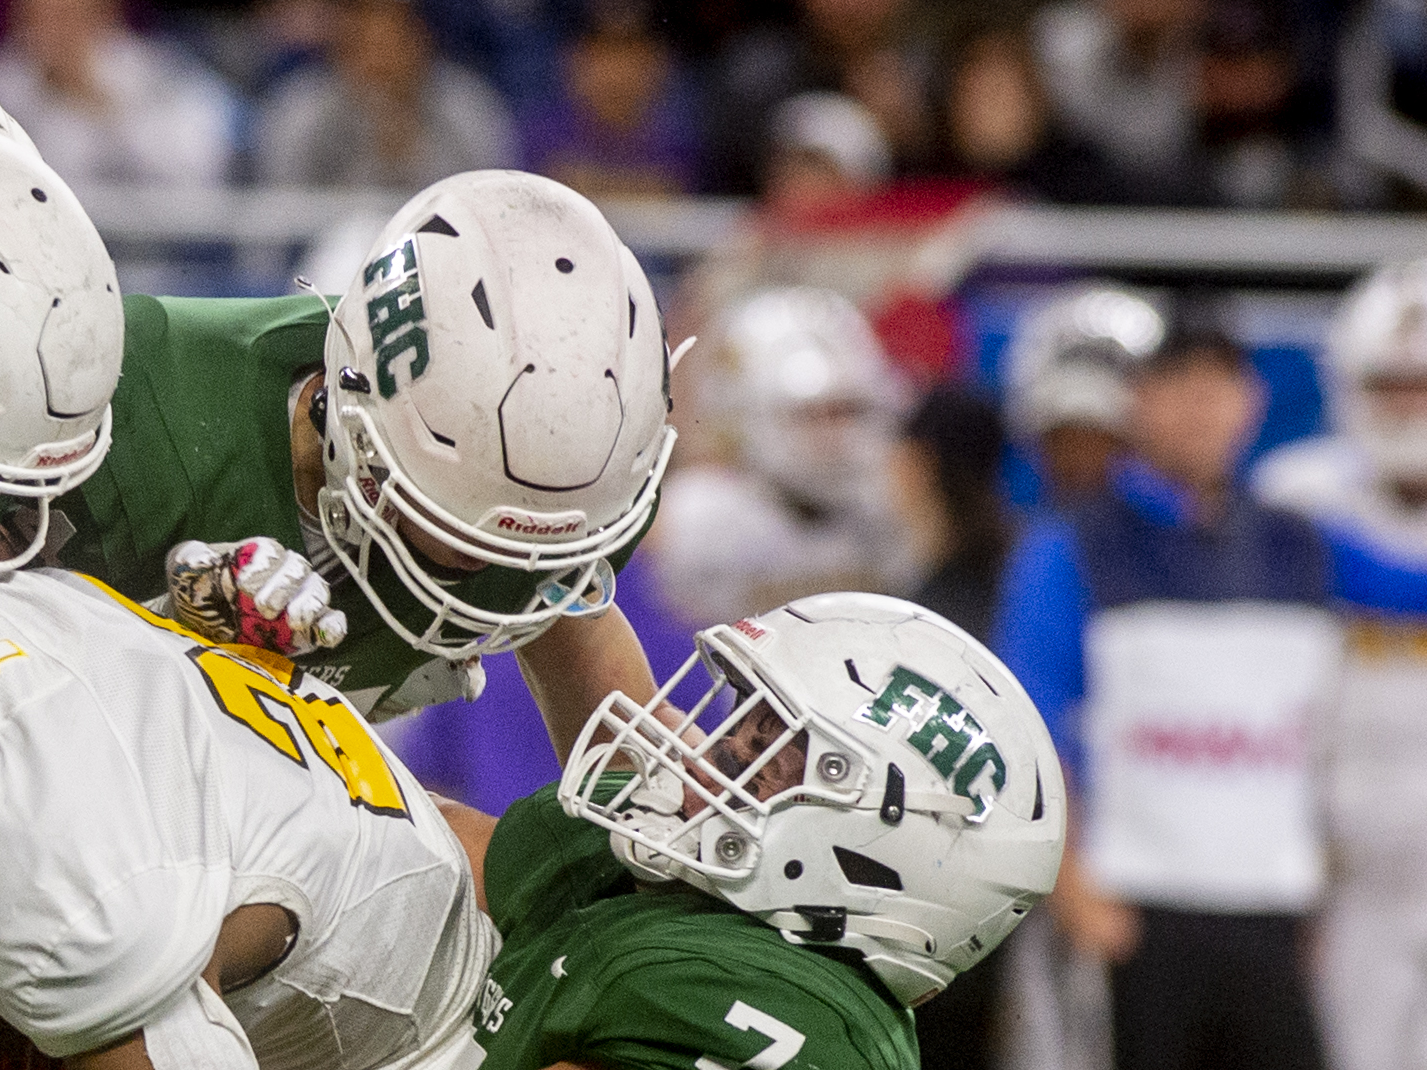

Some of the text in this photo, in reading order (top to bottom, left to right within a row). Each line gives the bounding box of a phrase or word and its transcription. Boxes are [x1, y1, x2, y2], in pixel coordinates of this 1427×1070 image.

[363, 236, 430, 401] FHC
[497, 516, 580, 537] Riddell
[856, 665, 1008, 822] FHC
